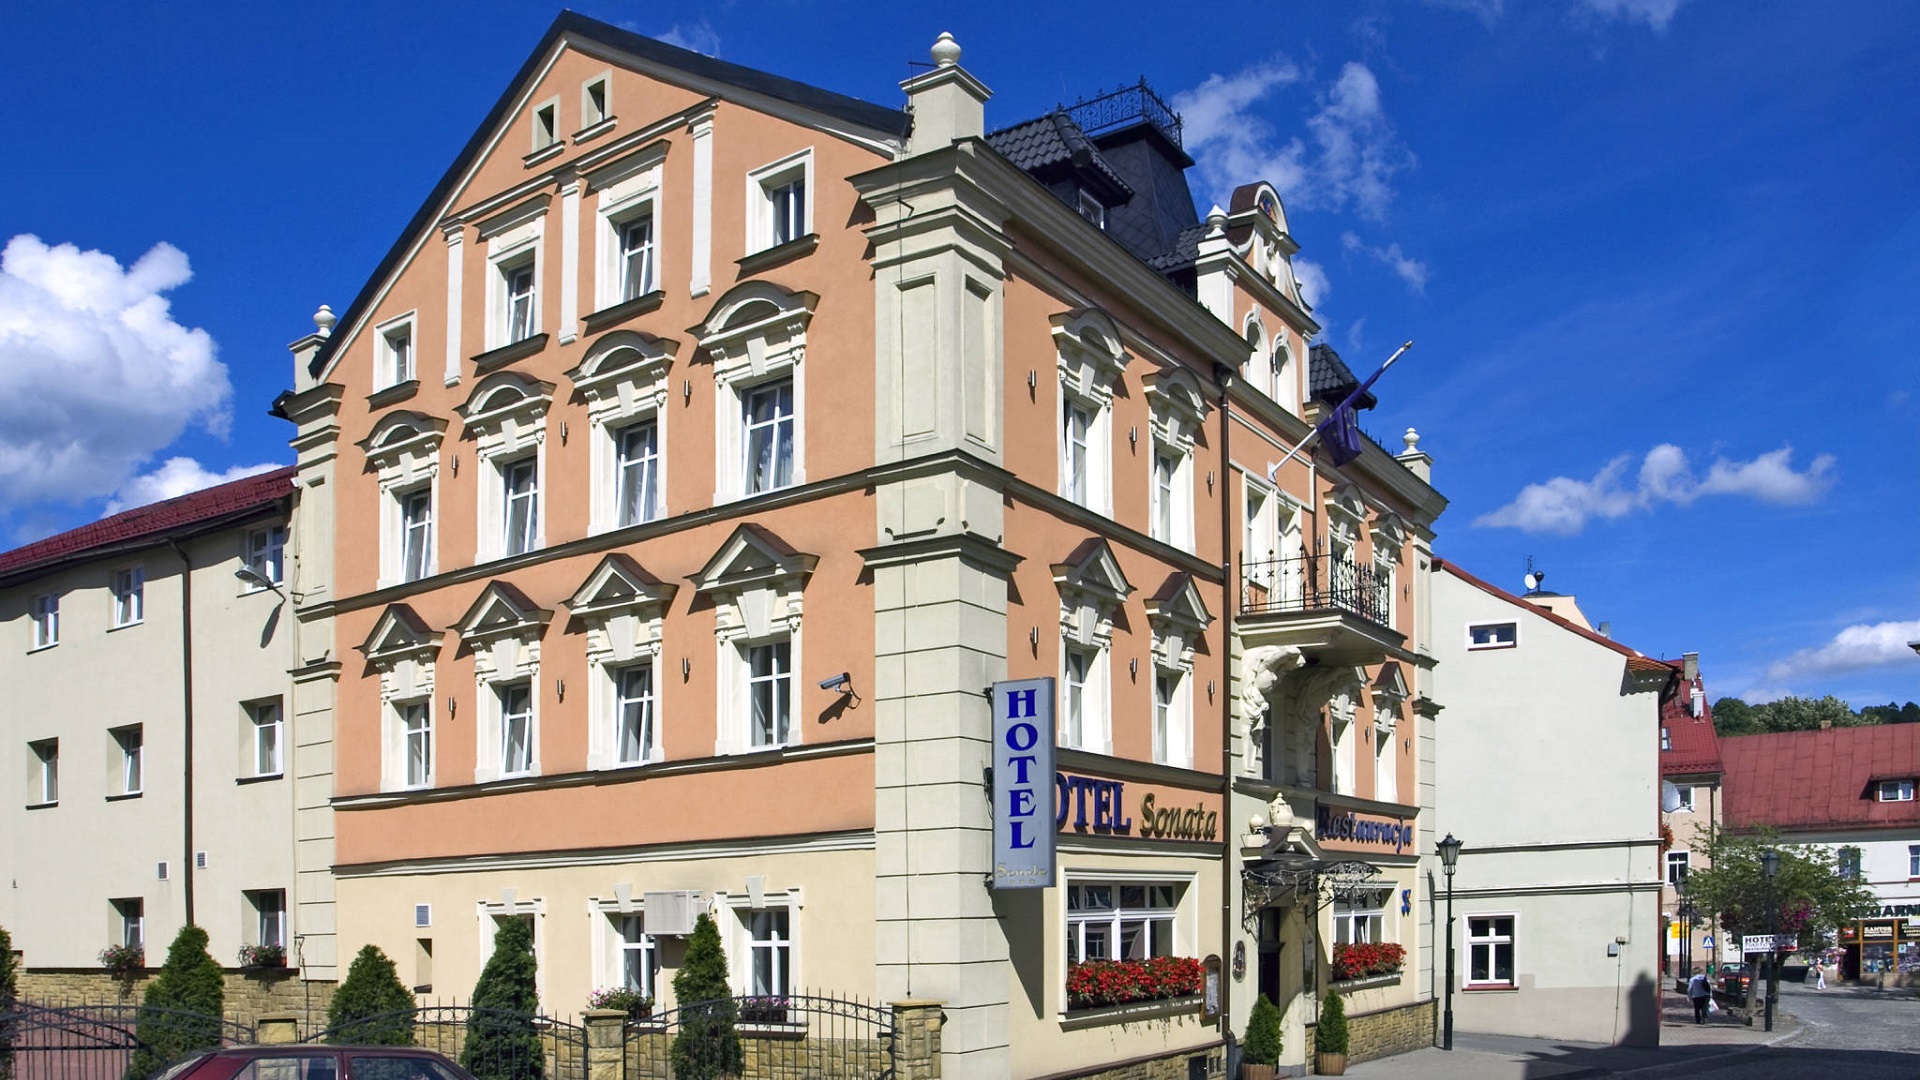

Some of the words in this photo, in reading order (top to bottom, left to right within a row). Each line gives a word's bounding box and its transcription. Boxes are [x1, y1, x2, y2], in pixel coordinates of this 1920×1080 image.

[1006, 689, 1038, 849] HOTEL
[1056, 772, 1131, 835] OTEL
[1140, 793, 1217, 840] Sonata
[1318, 806, 1413, 854] Restauracja
